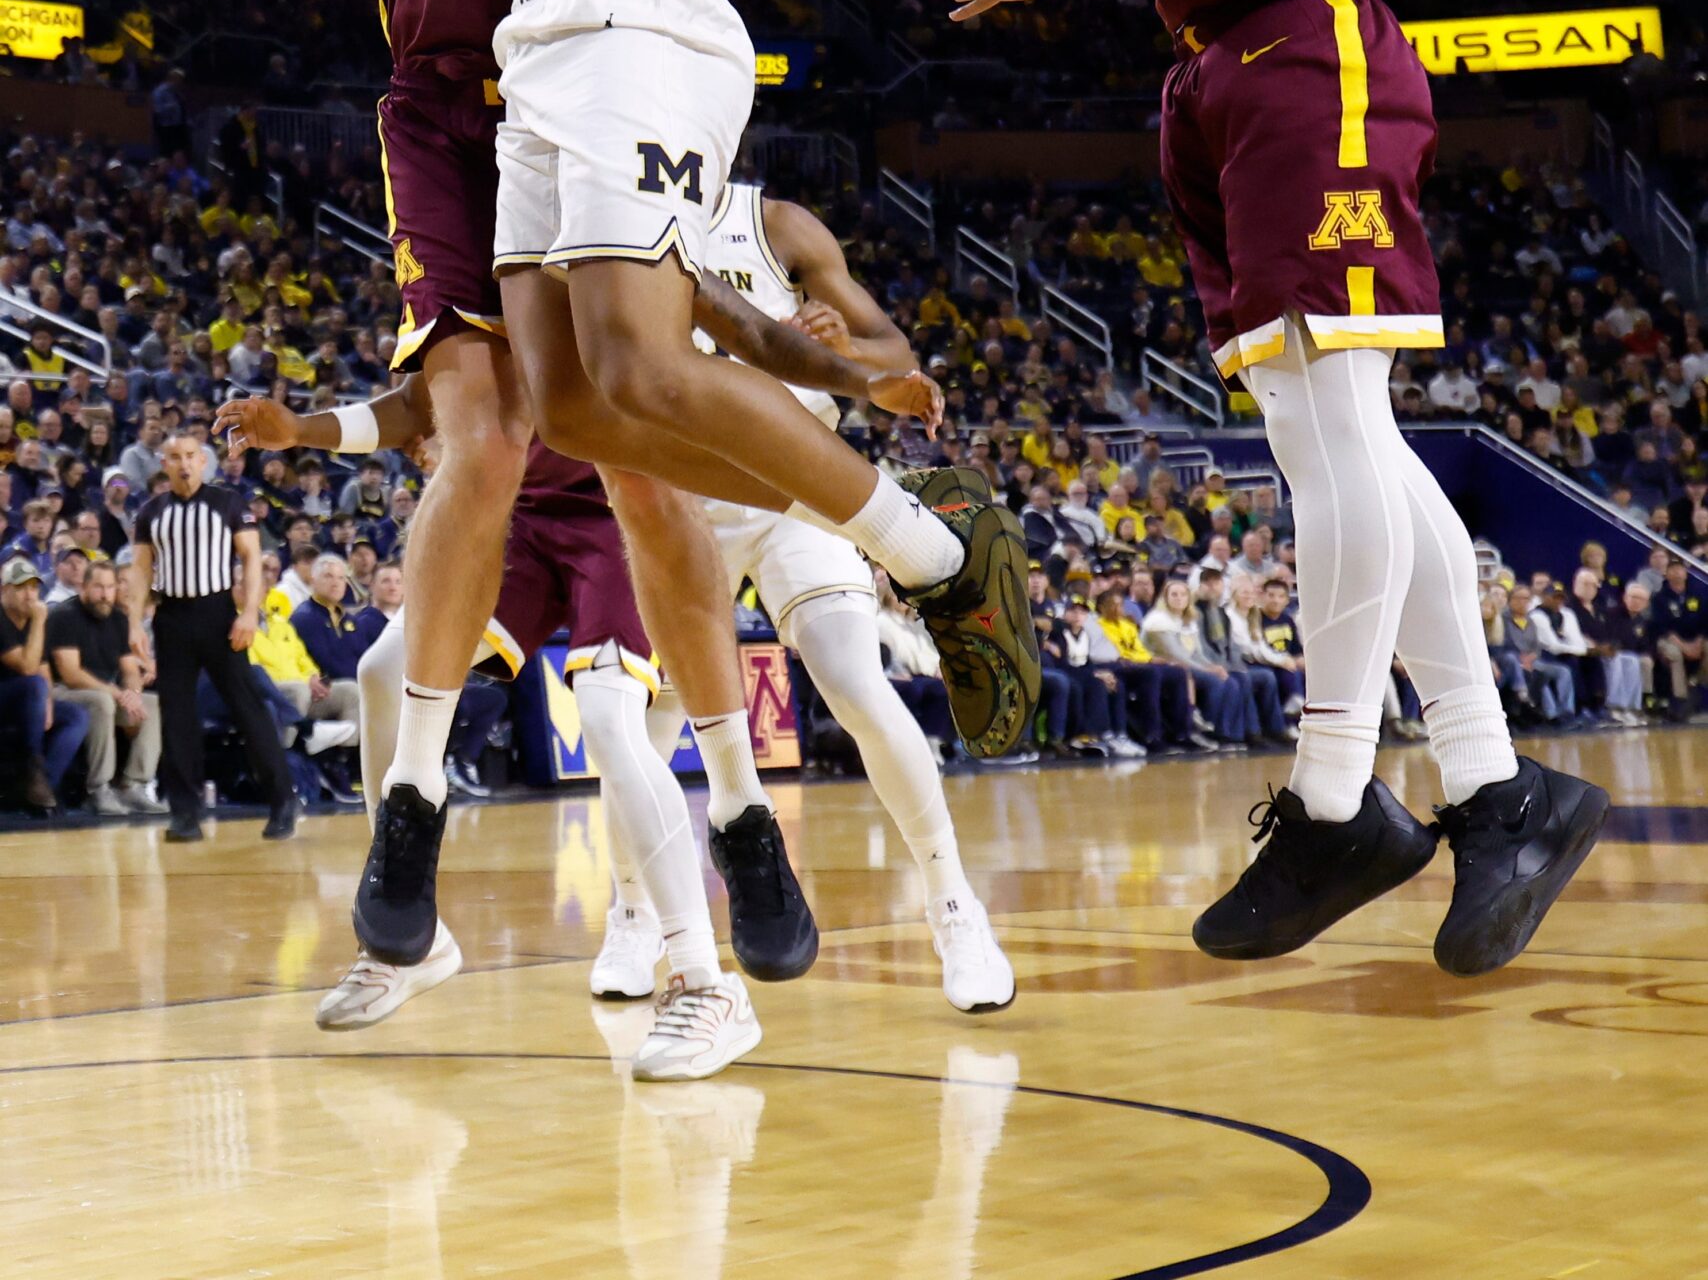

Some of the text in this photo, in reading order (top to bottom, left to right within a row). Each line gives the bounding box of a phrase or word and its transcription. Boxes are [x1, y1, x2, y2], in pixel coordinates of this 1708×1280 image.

[1407, 22, 1645, 61] ISSAN
[636, 141, 704, 207] M
[1308, 190, 1394, 250] M
